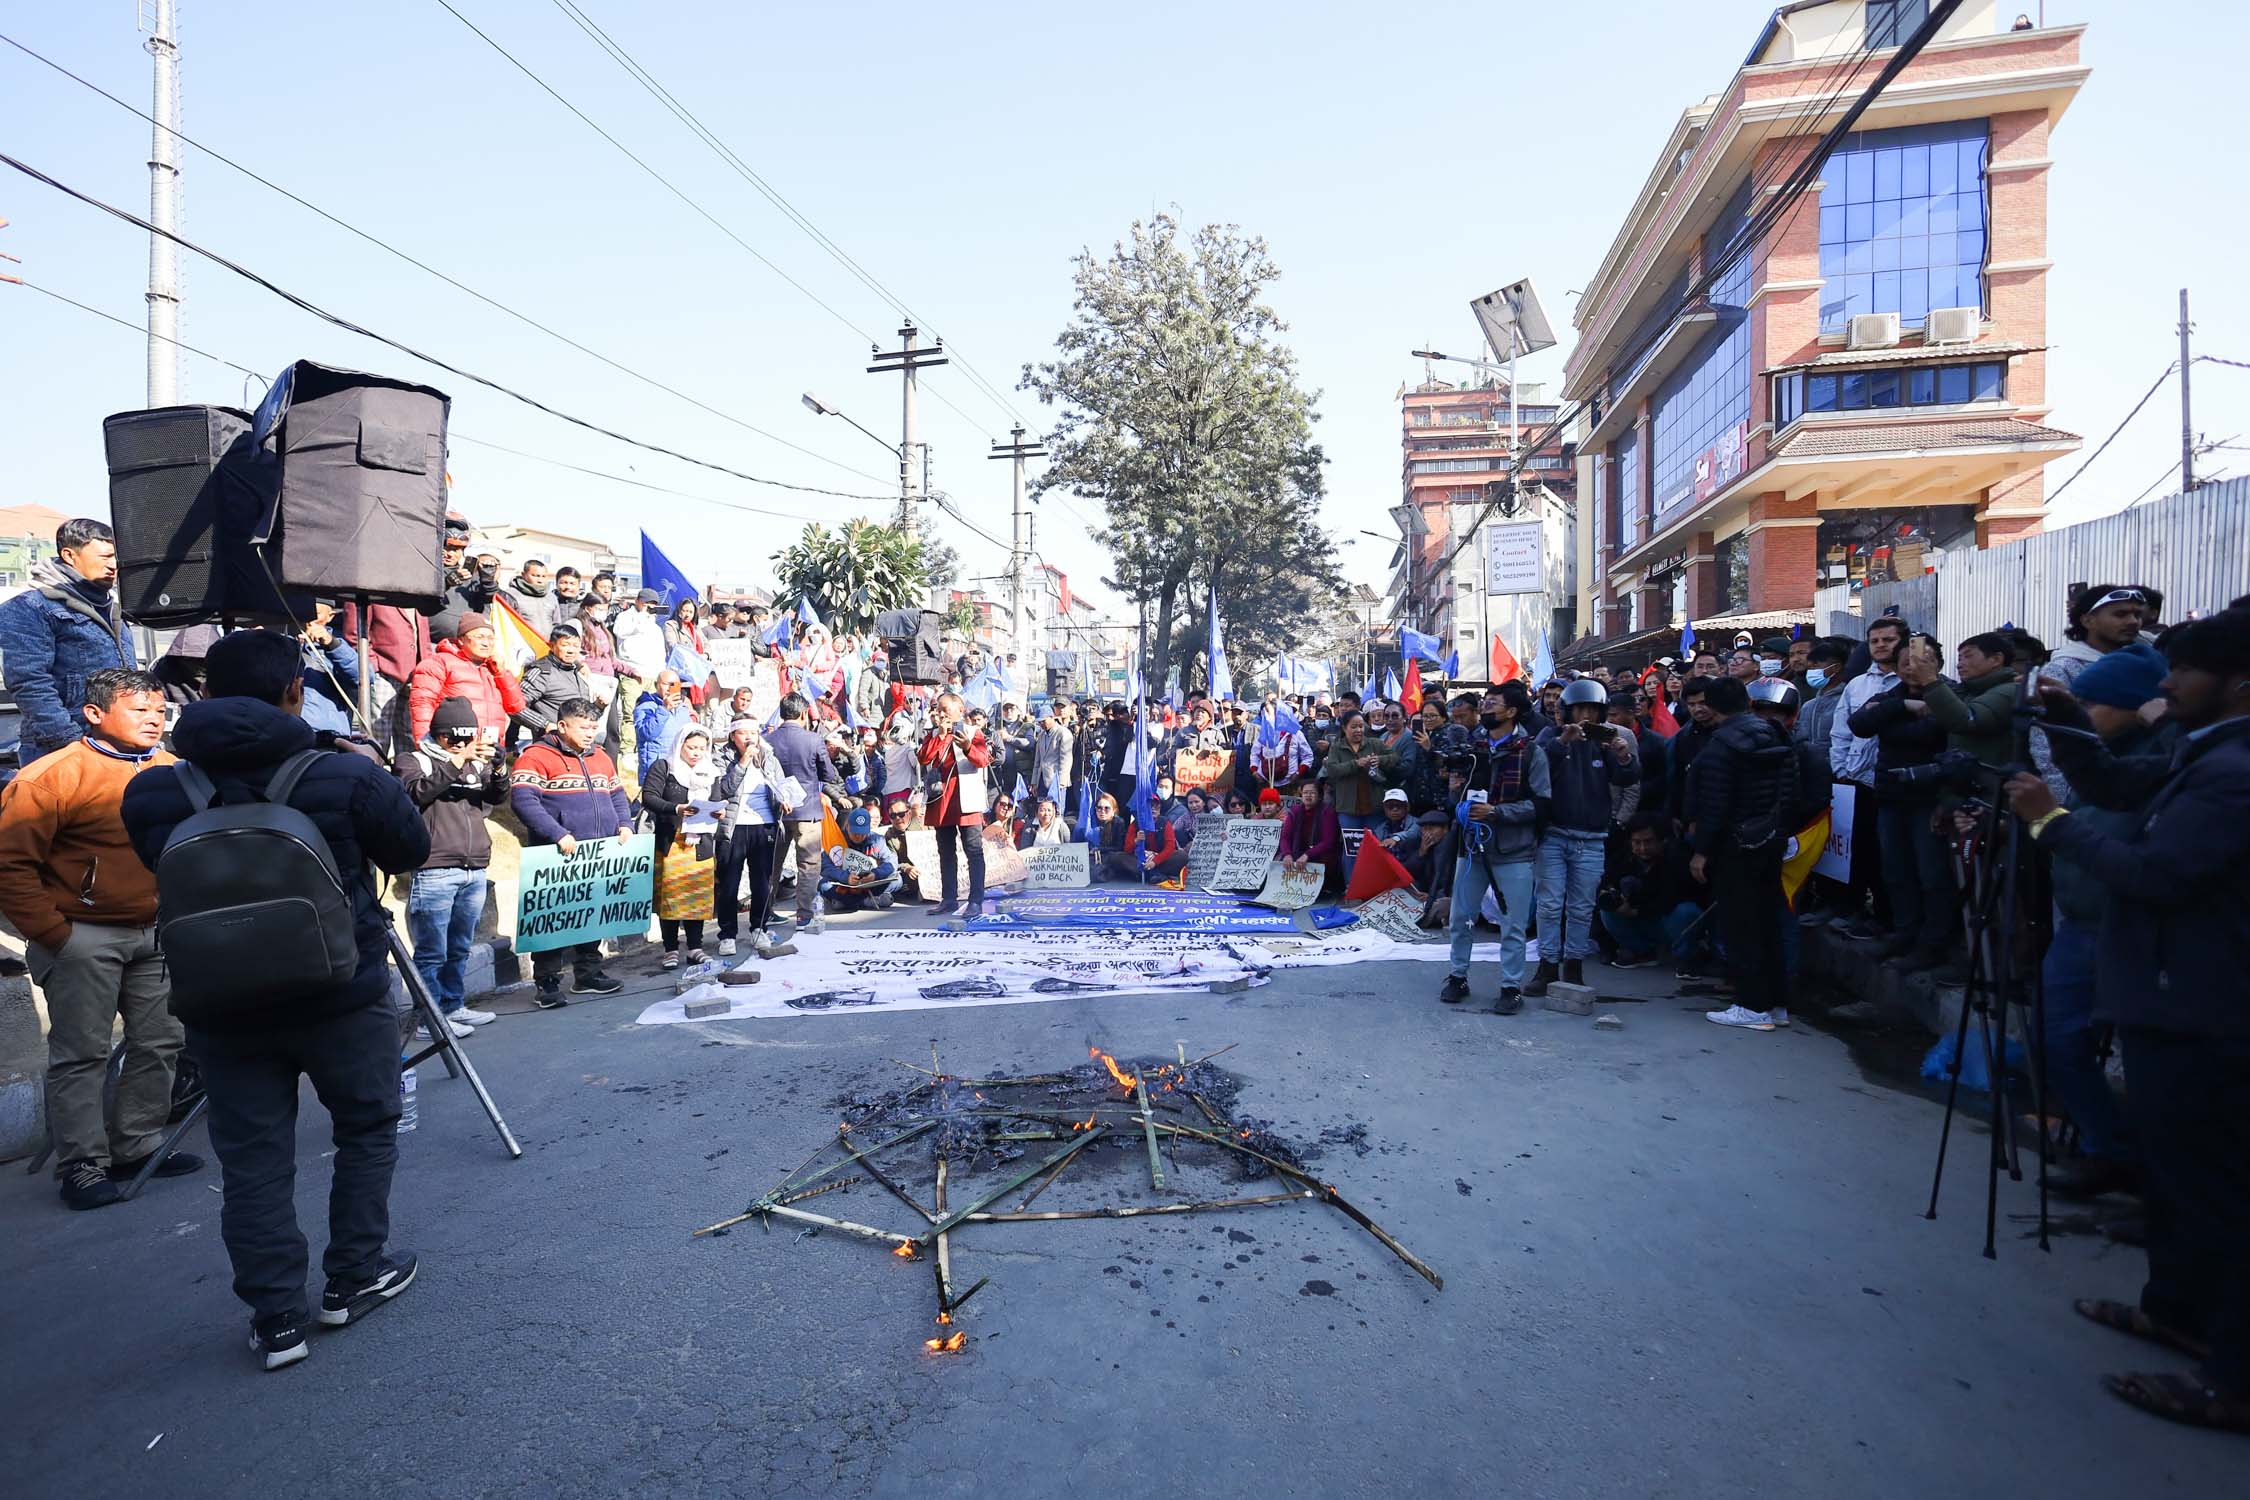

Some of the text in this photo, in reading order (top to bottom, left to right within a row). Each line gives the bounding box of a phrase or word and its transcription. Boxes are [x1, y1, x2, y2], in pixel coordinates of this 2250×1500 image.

[1177, 768, 1217, 782] Global
[1038, 847, 1060, 855] STOP
[1025, 855, 1079, 864] ITARIZATION
[533, 856, 651, 887] MUKKUMLUNG
[1035, 873, 1073, 882] GO BACK
[523, 877, 631, 915] BECAUSE WE
[518, 900, 652, 937] WORSHIP NATURE
